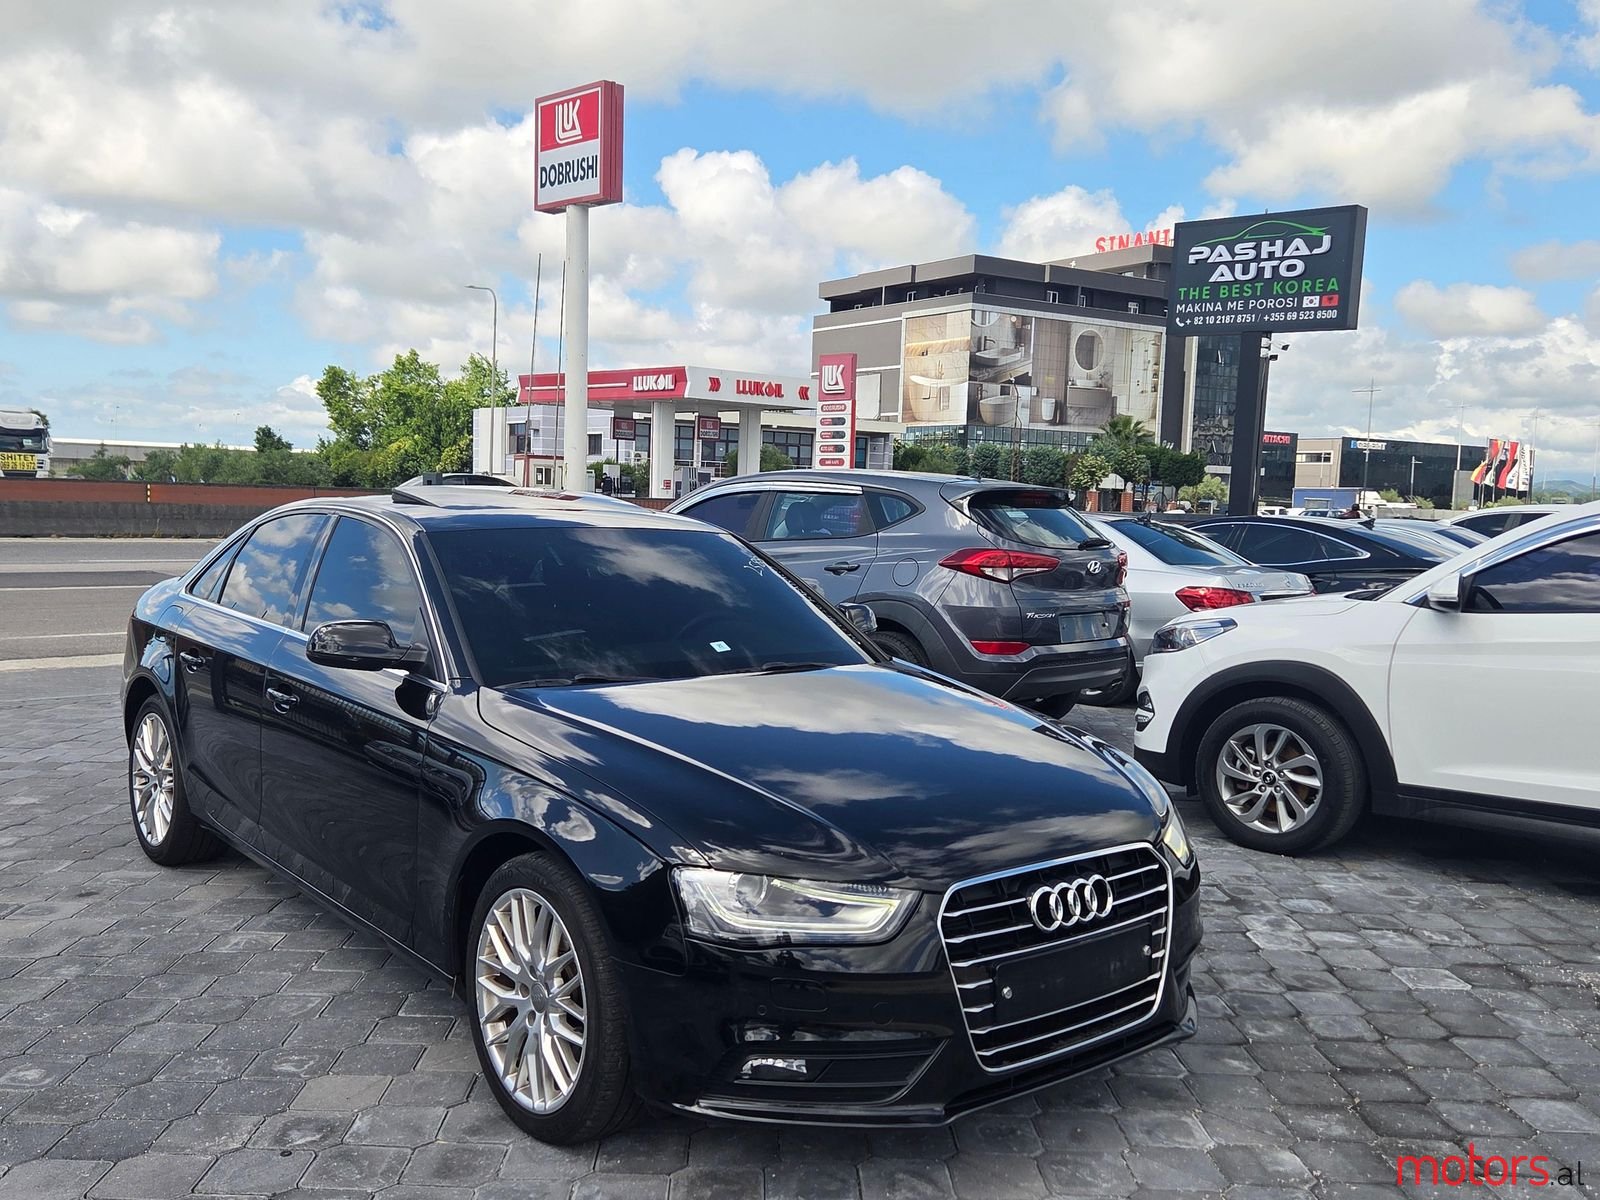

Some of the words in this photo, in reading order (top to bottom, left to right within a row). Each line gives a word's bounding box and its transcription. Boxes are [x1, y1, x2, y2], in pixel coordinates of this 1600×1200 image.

[540, 154, 598, 189] DOBRUSHI
[1188, 235, 1332, 264] PASHAJ
[1208, 259, 1305, 282] AUTO
[1178, 286, 1211, 300] THE
[1219, 282, 1264, 298] BEST
[1273, 277, 1339, 295] KOREA
[1176, 301, 1222, 313] MAKINA
[1227, 300, 1244, 311] ME
[1248, 297, 1298, 310] POROSI
[1193, 316, 1203, 325] 82
[1205, 315, 1215, 324] 10
[1236, 314, 1255, 323] 8751
[1263, 312, 1285, 322] +355
[1286, 311, 1298, 321] 69
[1299, 310, 1315, 320] 523
[1316, 309, 1338, 319] 8500
[0, 453, 35, 461] SHITET
